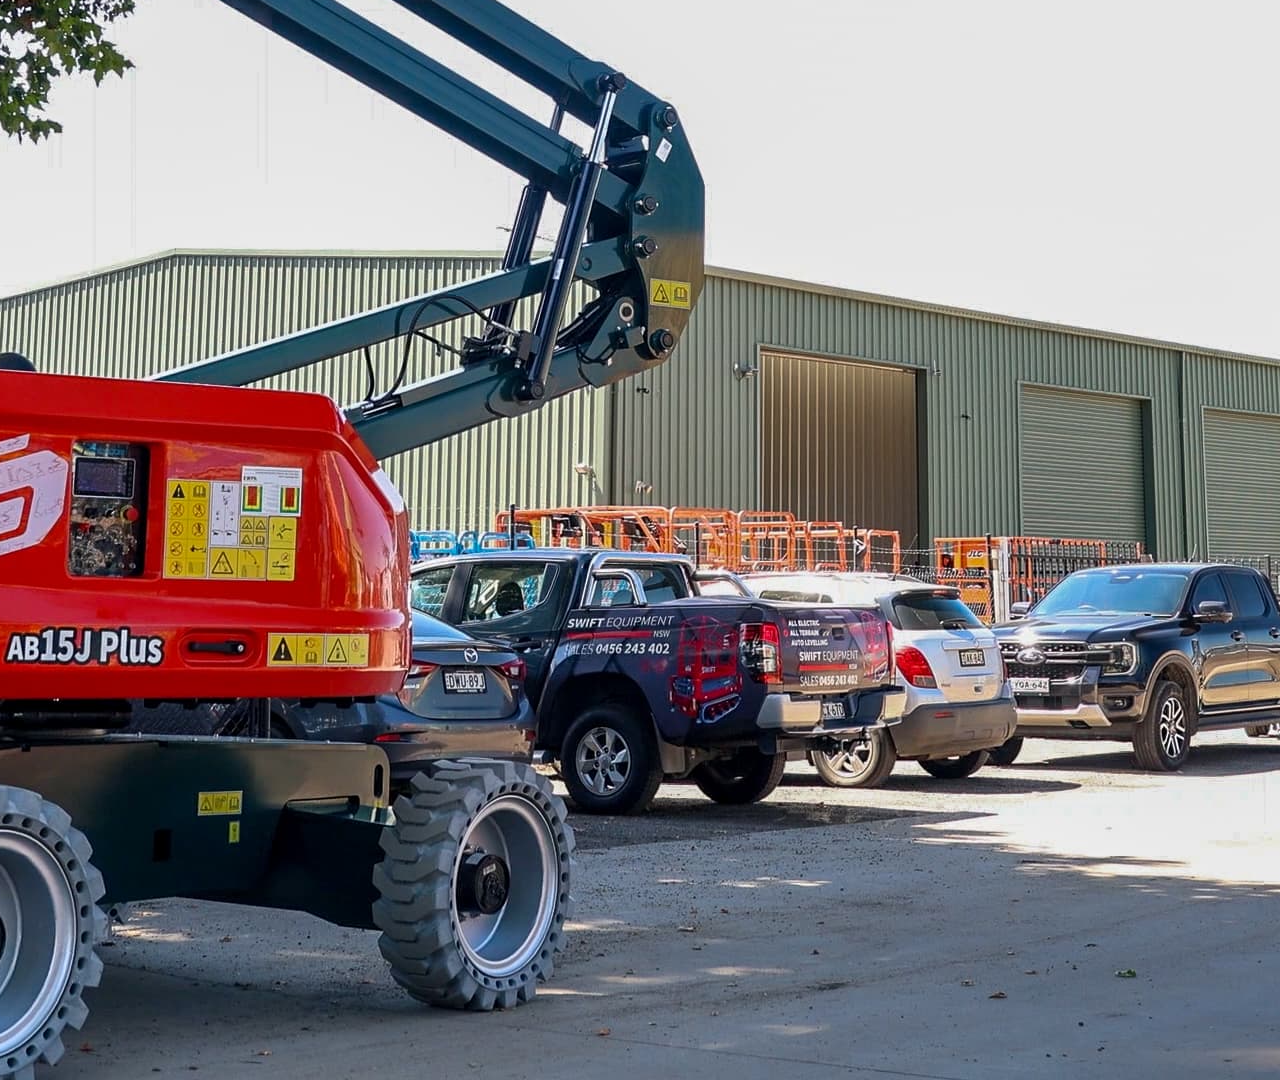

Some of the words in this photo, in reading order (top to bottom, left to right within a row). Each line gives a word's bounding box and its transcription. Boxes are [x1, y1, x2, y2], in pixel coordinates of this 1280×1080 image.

[567, 618, 605, 628] SWIFT
[606, 615, 675, 629] EQUIPMENT
[653, 630, 670, 638] NSW
[6, 628, 92, 663] AB15J
[99, 629, 163, 664] Plus
[565, 643, 594, 655] SALES
[595, 643, 622, 654] 0456
[624, 643, 646, 654] 243
[648, 643, 670, 654] 402
[799, 651, 821, 661] SWIFT
[822, 650, 858, 662] EQUIPMENT
[800, 675, 818, 687] SALES
[820, 675, 835, 686] 0456
